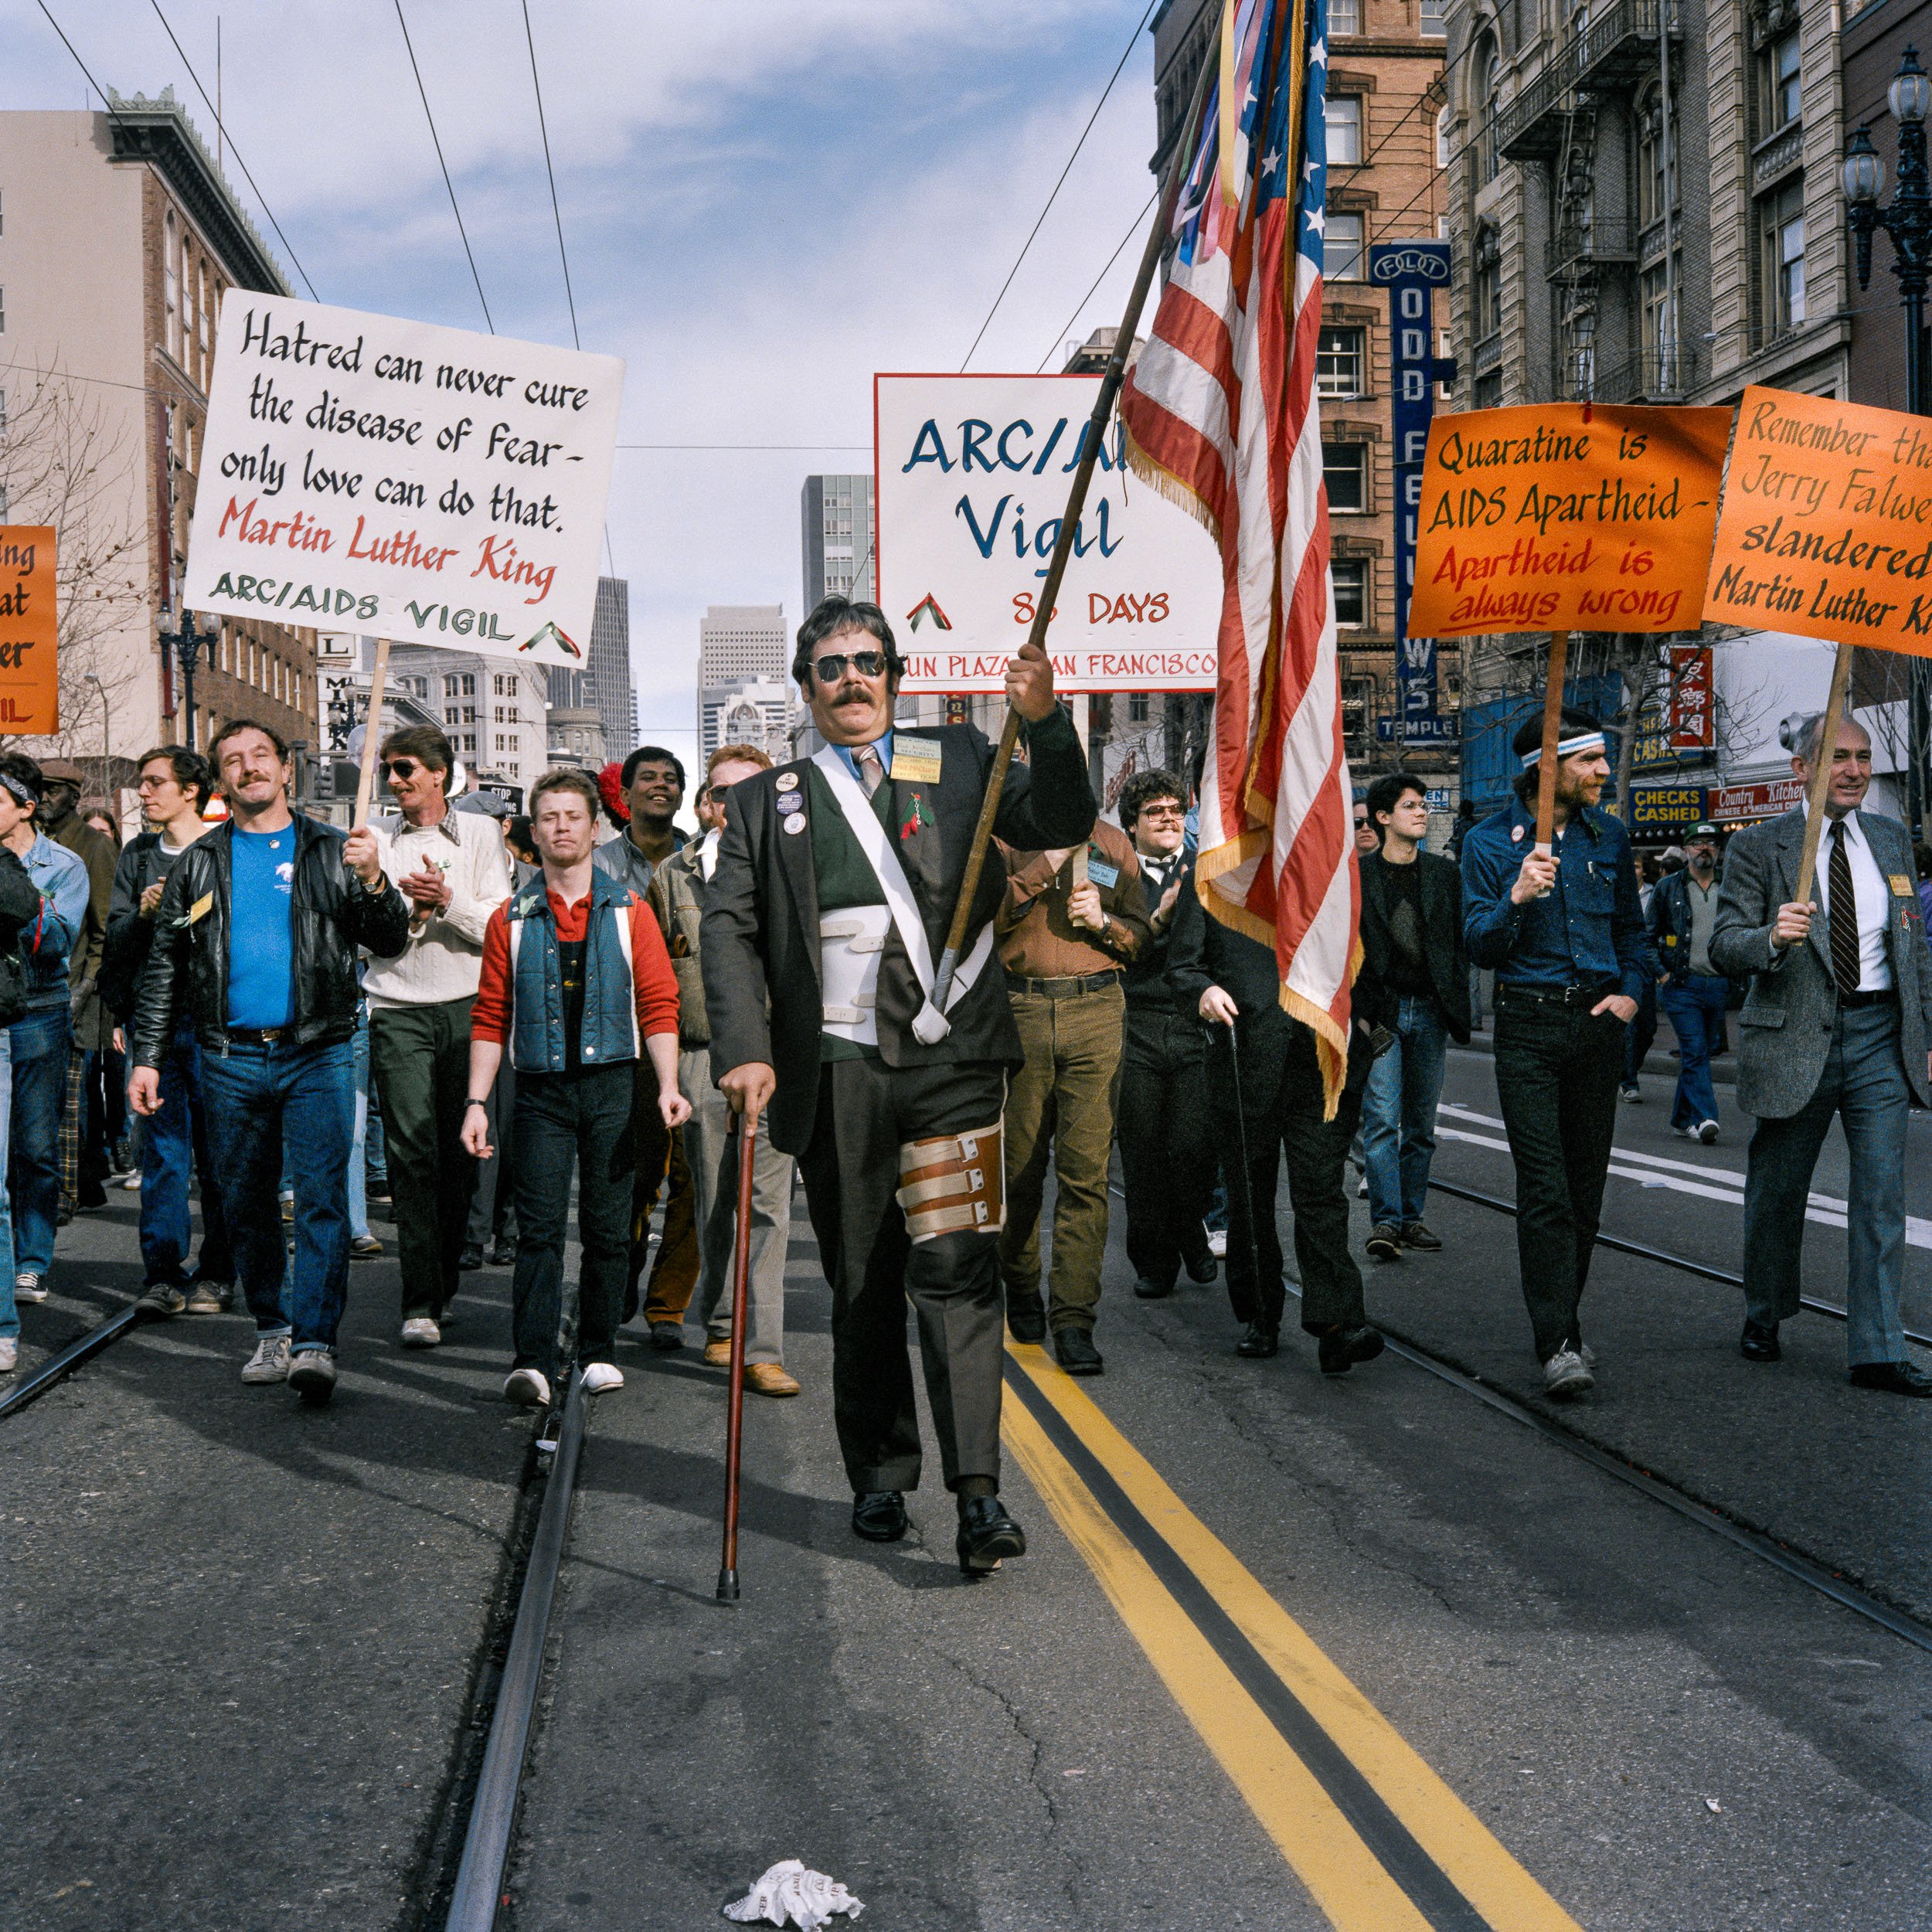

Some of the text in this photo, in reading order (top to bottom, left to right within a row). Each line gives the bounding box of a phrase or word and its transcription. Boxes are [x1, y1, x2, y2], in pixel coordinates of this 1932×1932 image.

[240, 308, 589, 412] Hatred can never cure
[249, 373, 293, 425] the
[306, 390, 423, 446] disease
[437, 417, 473, 453] of
[1747, 401, 1878, 457] Remember
[901, 417, 1128, 474] ARC/AI
[1437, 425, 1648, 475] Quaratine is
[220, 444, 563, 533] only love can do that.
[1427, 485, 1508, 534] AIDS
[1741, 454, 1932, 525] Jerry Falwe
[219, 494, 556, 604] Martin Luther King
[954, 494, 1124, 578] Vigil
[1431, 536, 1655, 592] Apartheid is
[1740, 515, 1932, 580] slandered
[209, 572, 515, 640] ARC/AIDS VIGIL
[1012, 592, 1169, 624] 8 DAYS
[1447, 584, 1683, 626] always wrong
[1713, 563, 1805, 613] Martin
[1808, 578, 1899, 628] Luther
[1051, 655, 1077, 676] AN
[1087, 653, 1216, 677] FRANCISCO
[1382, 720, 1453, 735] TEMPLE
[1634, 791, 1700, 806] CHECKS
[1634, 808, 1701, 821] CASHED
[1714, 806, 1741, 817] CHINESE
[1750, 801, 1783, 813] AMERICAN
[1719, 788, 1755, 809] Country
